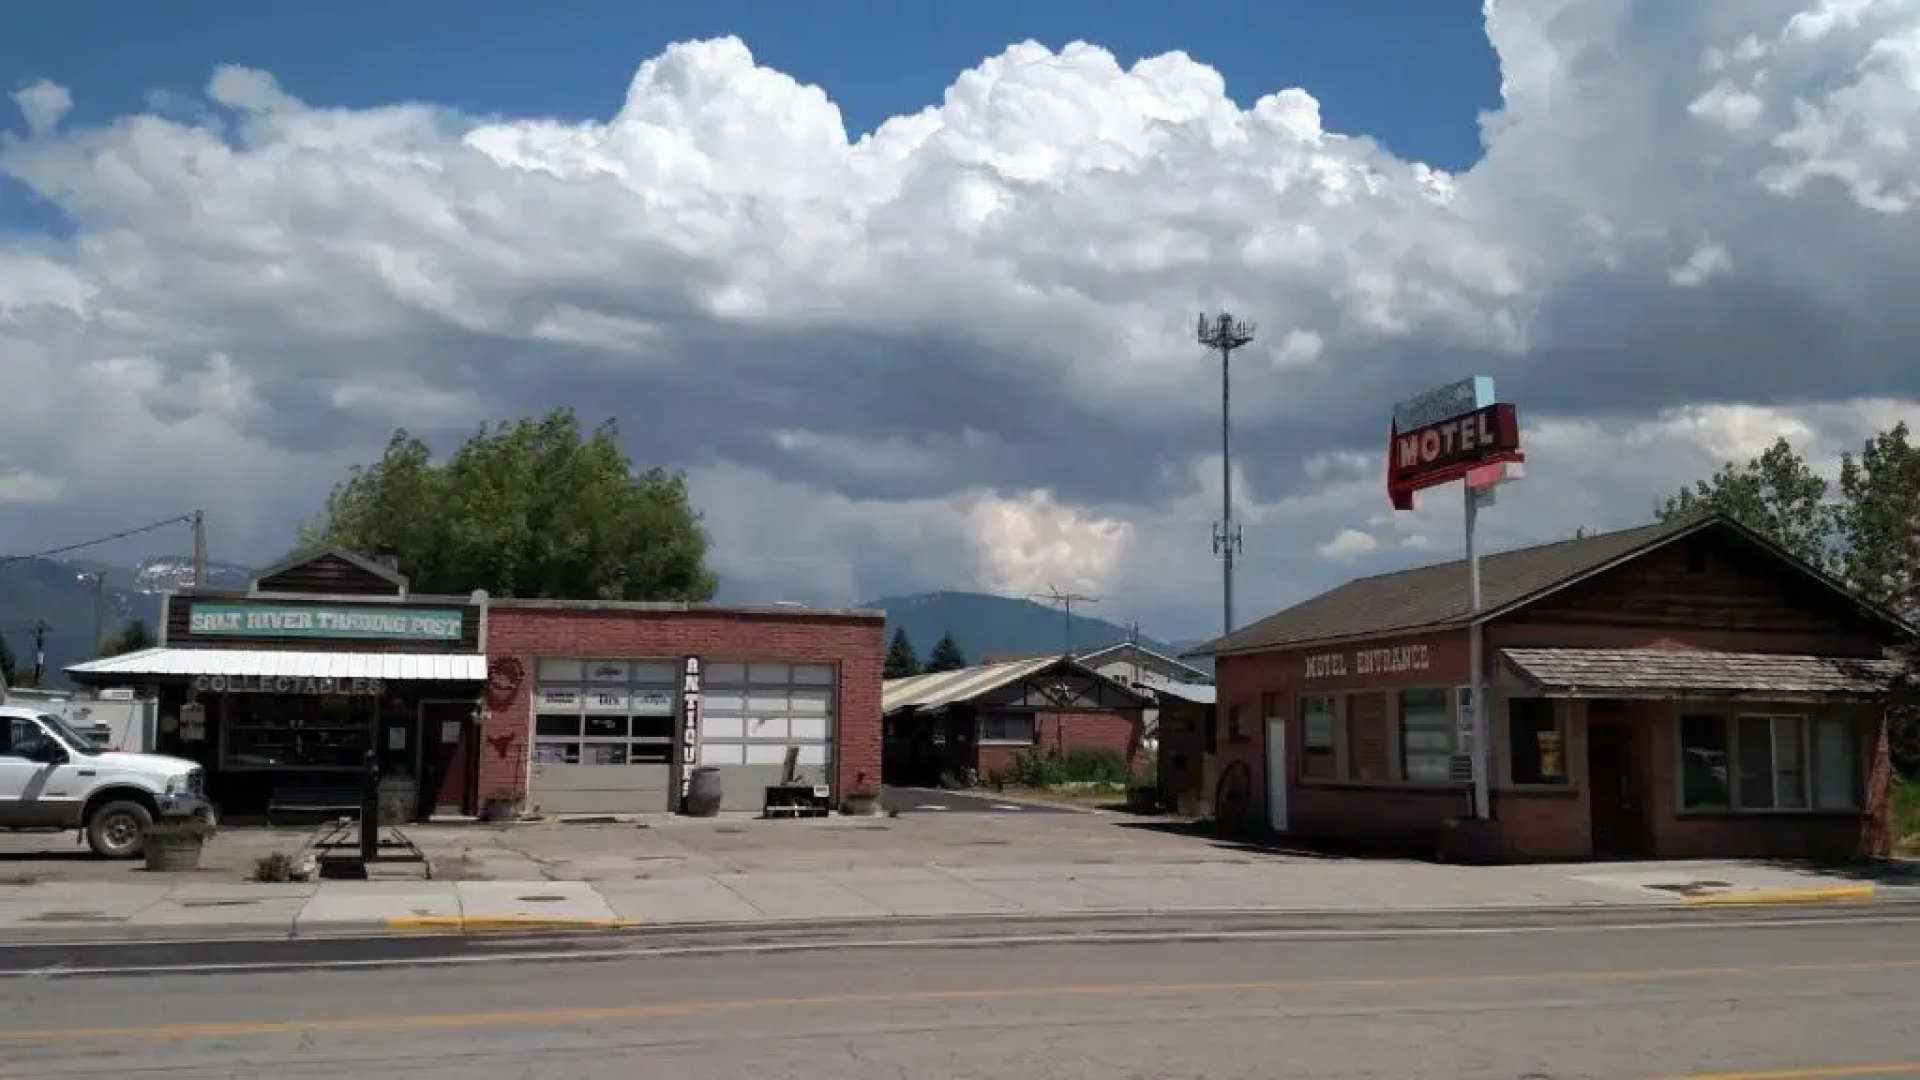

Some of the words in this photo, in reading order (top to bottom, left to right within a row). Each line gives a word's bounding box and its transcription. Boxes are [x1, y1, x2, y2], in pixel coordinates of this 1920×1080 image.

[1397, 413, 1494, 468] MOTEL
[192, 612, 241, 630] SALT
[247, 612, 312, 629] RIVER
[318, 612, 406, 632] TRADING
[411, 619, 461, 636] POST
[1305, 653, 1347, 678] MOTEL
[1357, 645, 1430, 674] ENTRANCE
[195, 675, 385, 695] COLLECTABLES
